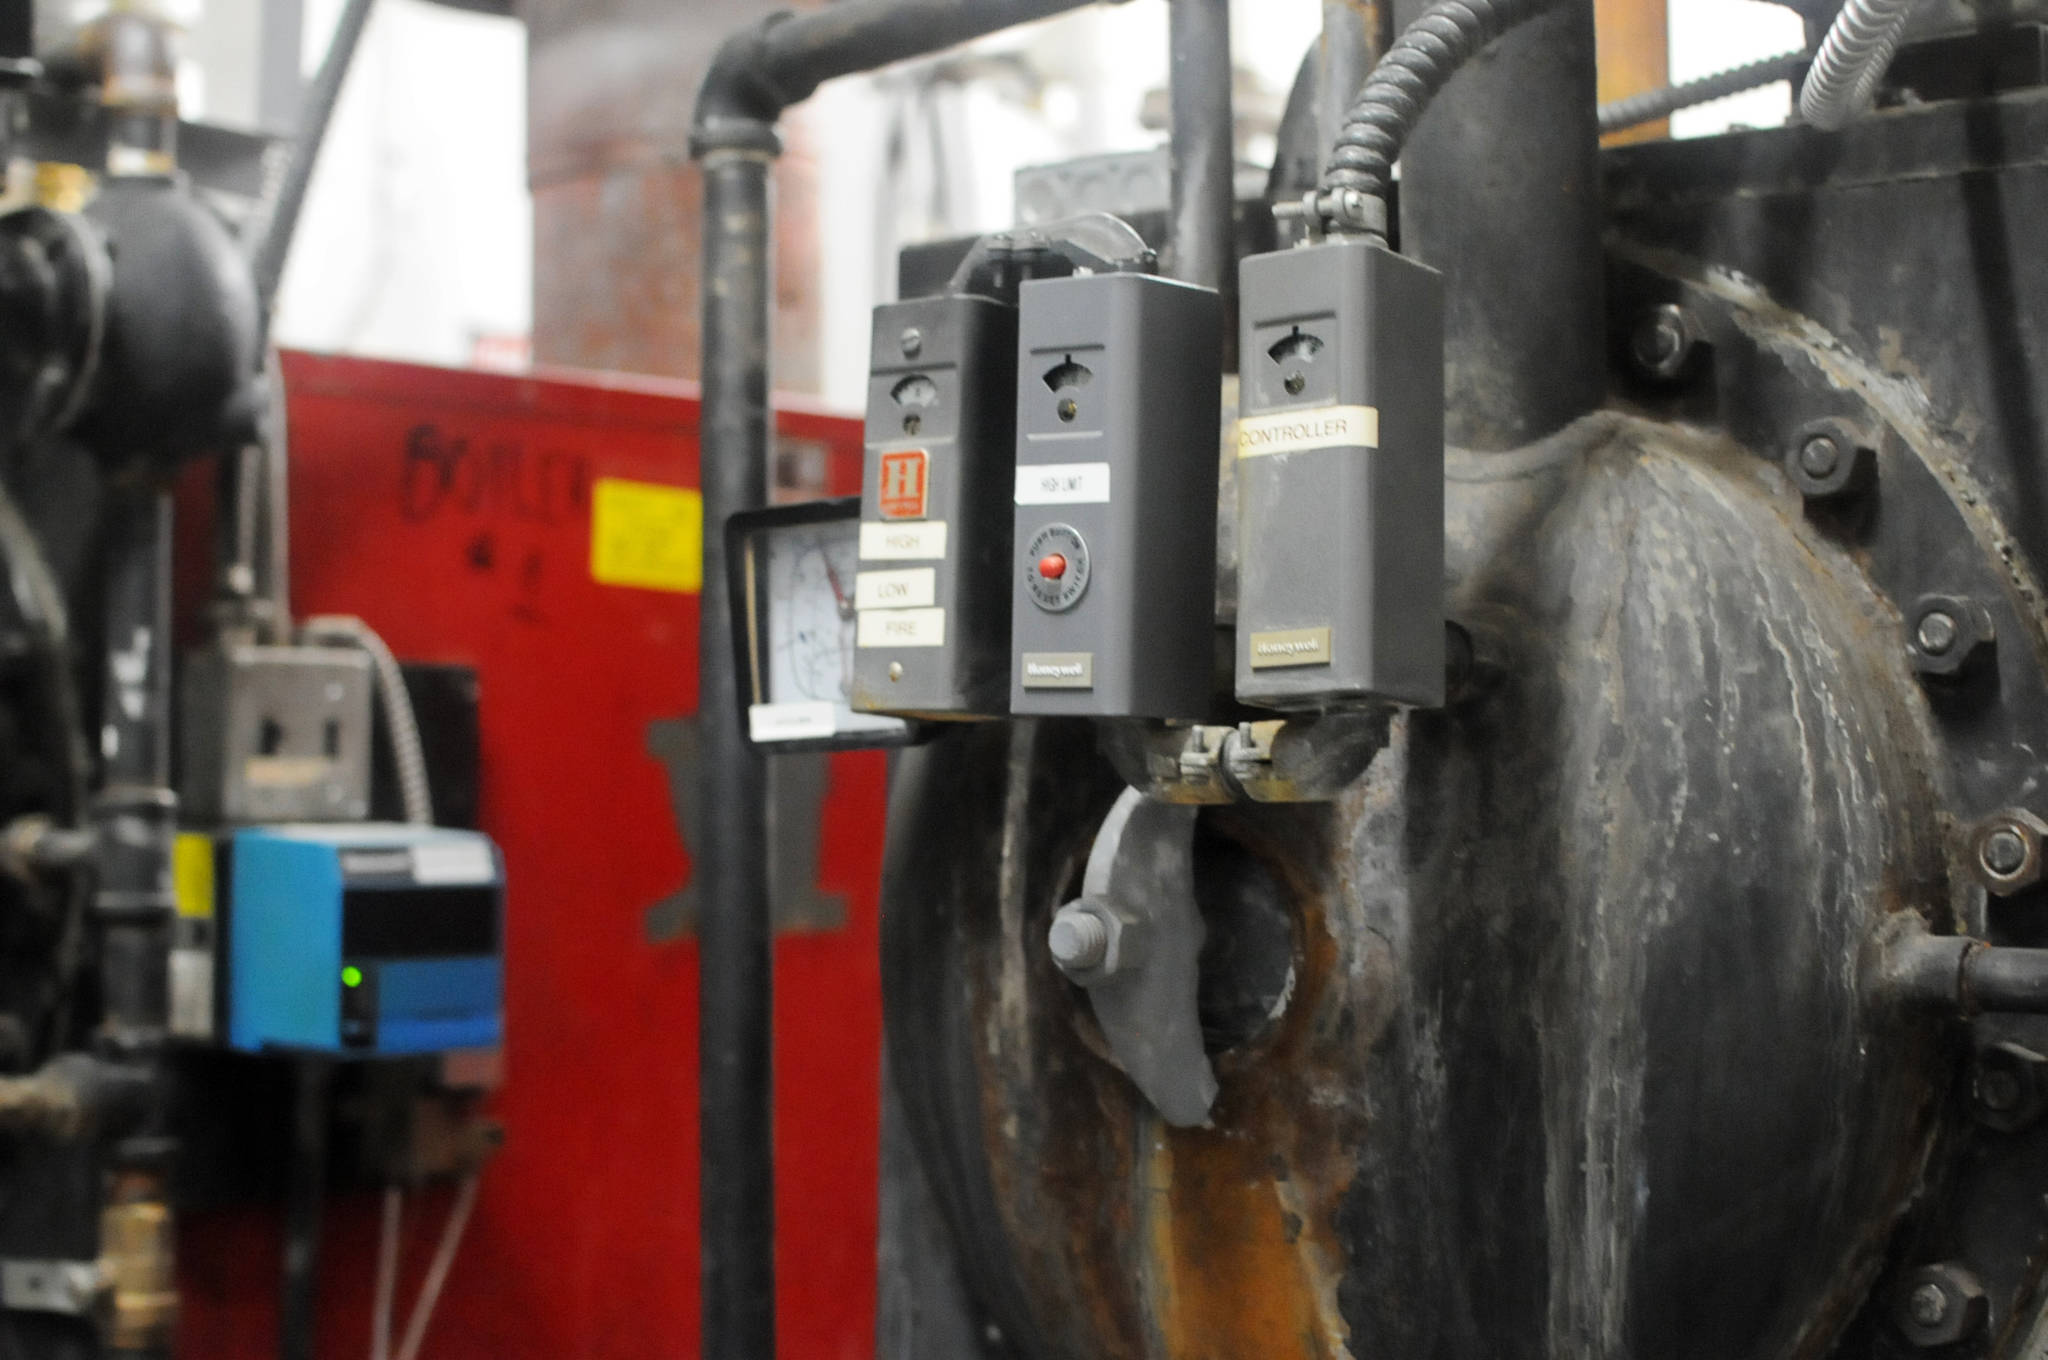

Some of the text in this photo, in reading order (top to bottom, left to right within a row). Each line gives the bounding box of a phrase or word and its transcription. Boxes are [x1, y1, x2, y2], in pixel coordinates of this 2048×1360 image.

[1239, 418, 1347, 447] CONTROLLER
[886, 534, 920, 549] HIGH
[878, 582, 909, 599] LOW
[885, 620, 918, 637] FIRE
[1257, 637, 1320, 657] Honeywell
